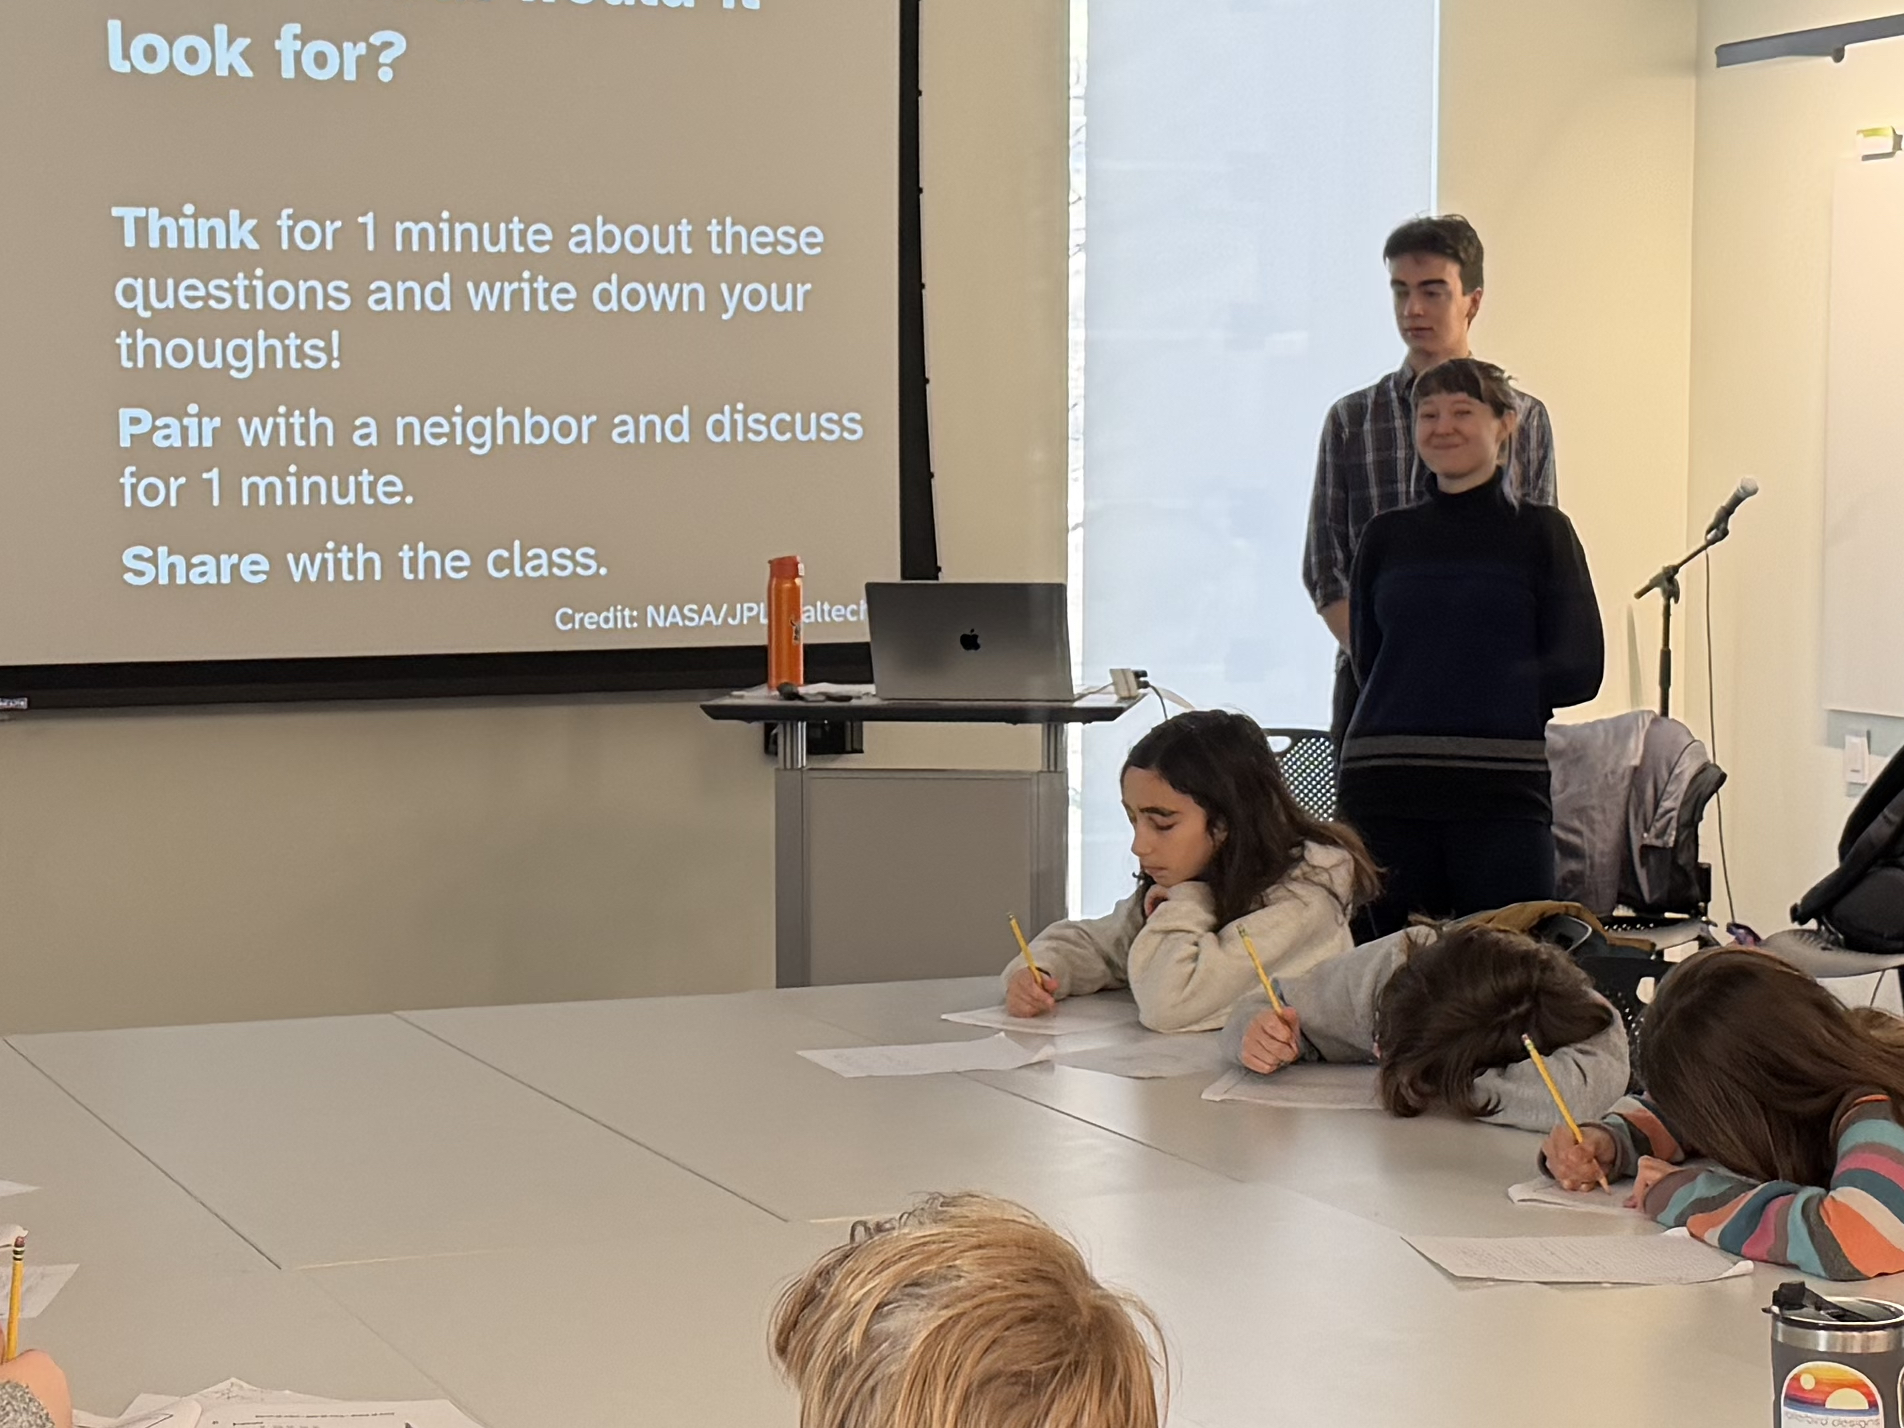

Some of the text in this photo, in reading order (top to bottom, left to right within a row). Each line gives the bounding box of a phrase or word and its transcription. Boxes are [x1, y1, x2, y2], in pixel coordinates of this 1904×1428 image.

[108, 20, 406, 82] look for?
[111, 204, 824, 255] Think for 1 minute about these
[115, 268, 811, 320] questions and write down your
[116, 329, 340, 378] thoughts!
[119, 403, 863, 455] Pair with a neighbor and discuss
[120, 464, 413, 507] for 1 minute.
[122, 540, 607, 585] Share with the class.
[556, 600, 867, 630] Credit: NASA/JPLaltech
